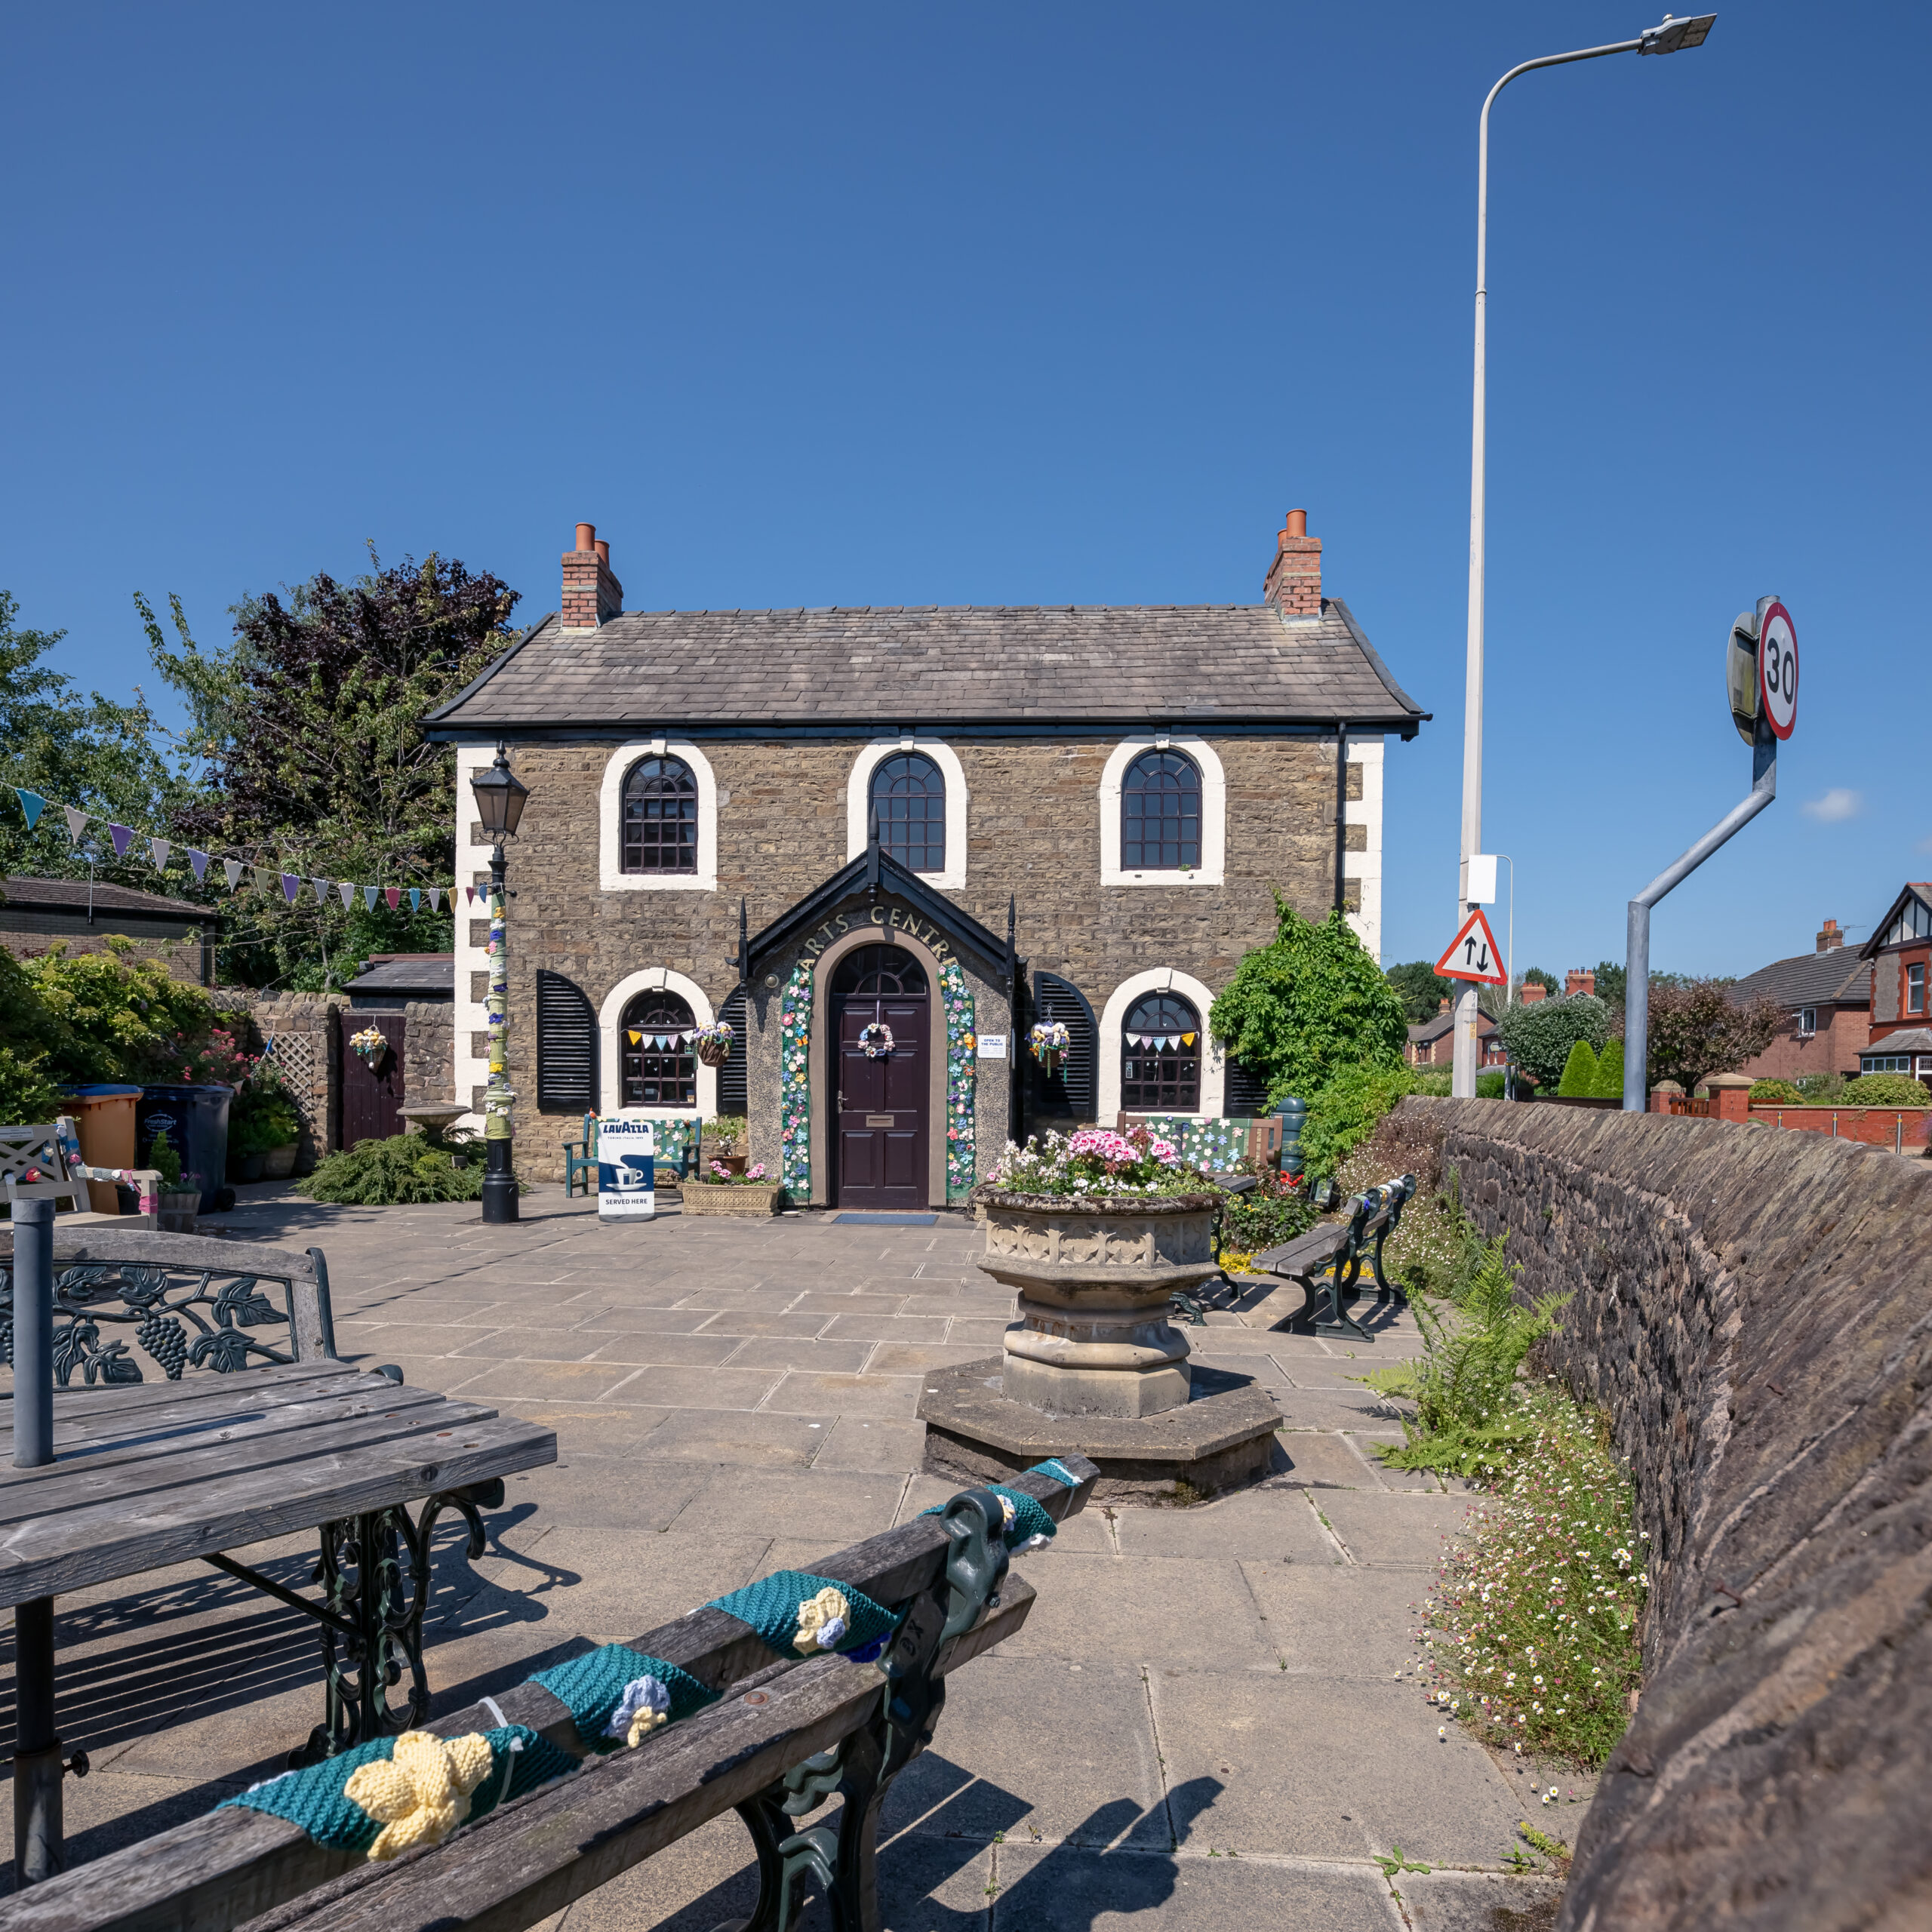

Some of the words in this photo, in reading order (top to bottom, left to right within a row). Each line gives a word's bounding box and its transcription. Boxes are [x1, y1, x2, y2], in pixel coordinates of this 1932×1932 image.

[1766, 637, 1795, 705] 30
[795, 913, 849, 971] ARTS
[603, 1121, 649, 1134] LAVAZZA
